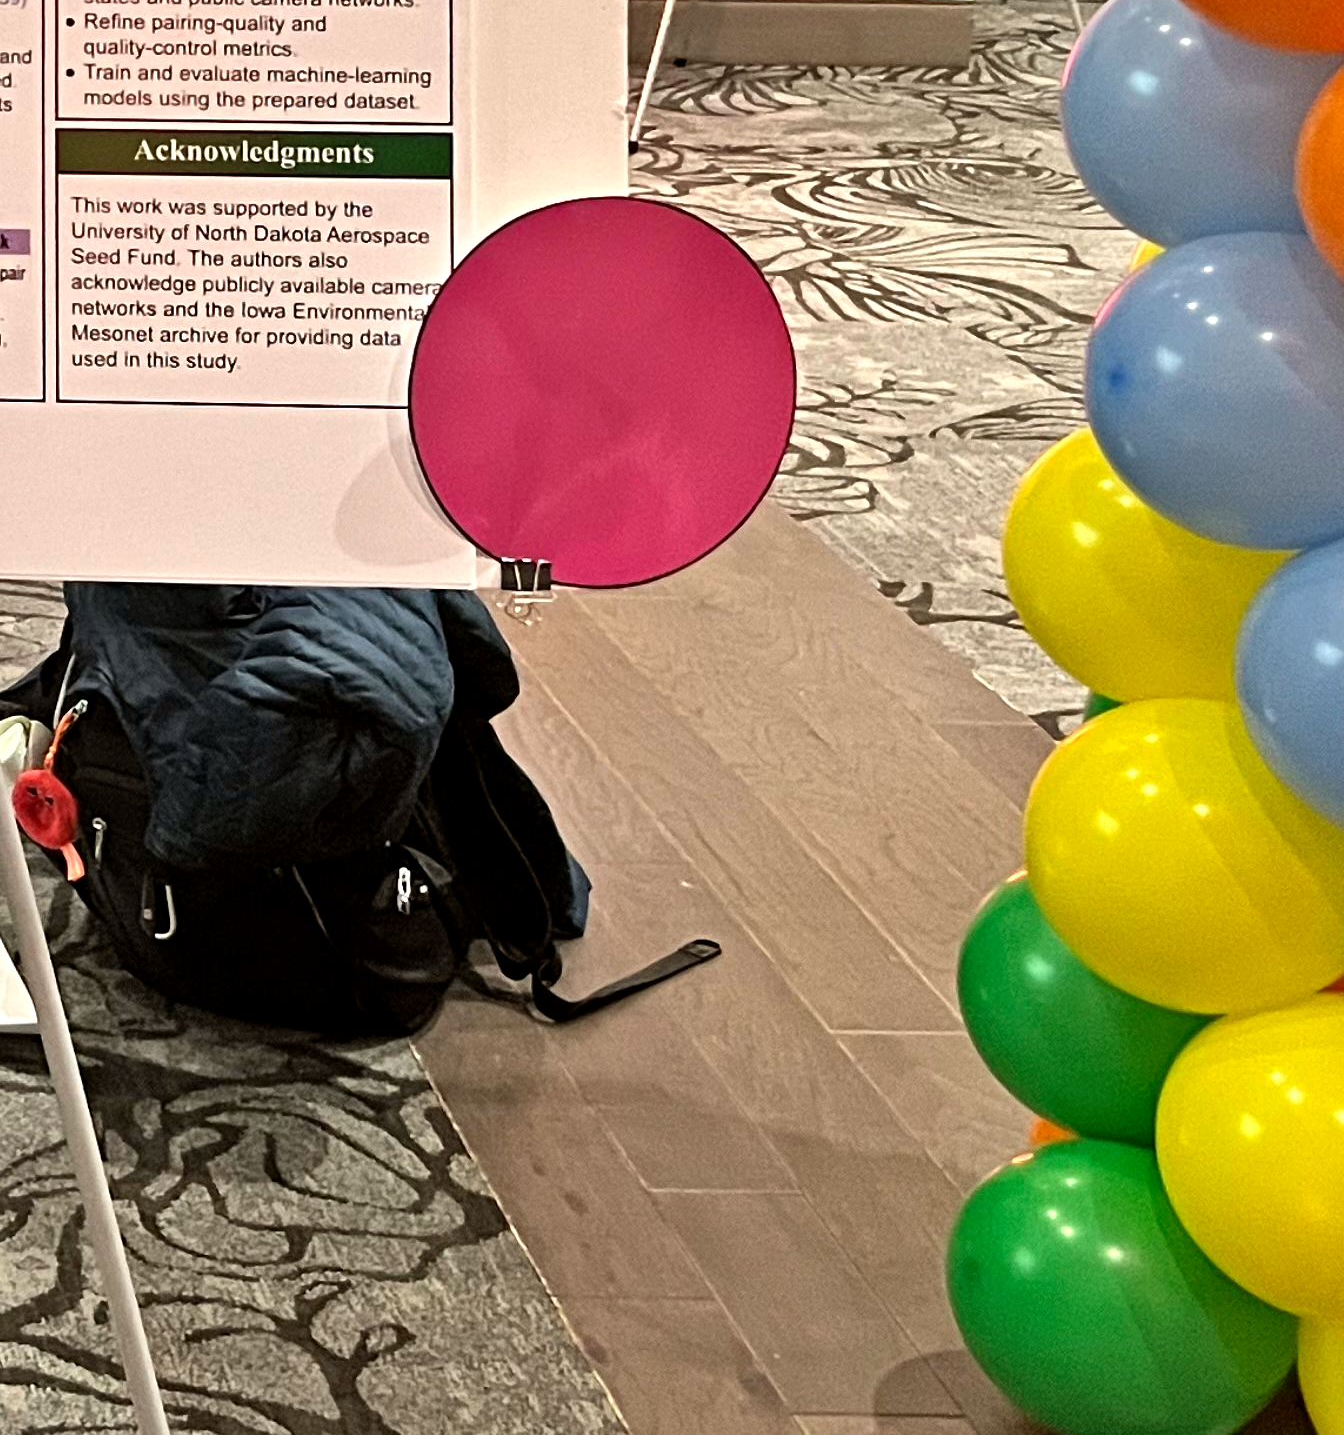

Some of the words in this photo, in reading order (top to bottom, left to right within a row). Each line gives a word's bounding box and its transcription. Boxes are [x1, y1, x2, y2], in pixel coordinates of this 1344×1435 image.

[135, 139, 374, 169] Acknowledgments
[71, 274, 196, 295] acknowledge
[203, 276, 274, 297] publicly
[281, 277, 364, 294] available
[72, 300, 156, 316] networks
[164, 301, 198, 317] and
[206, 302, 234, 317] the
[242, 302, 285, 319] Iowa
[294, 300, 430, 321] Environmenta
